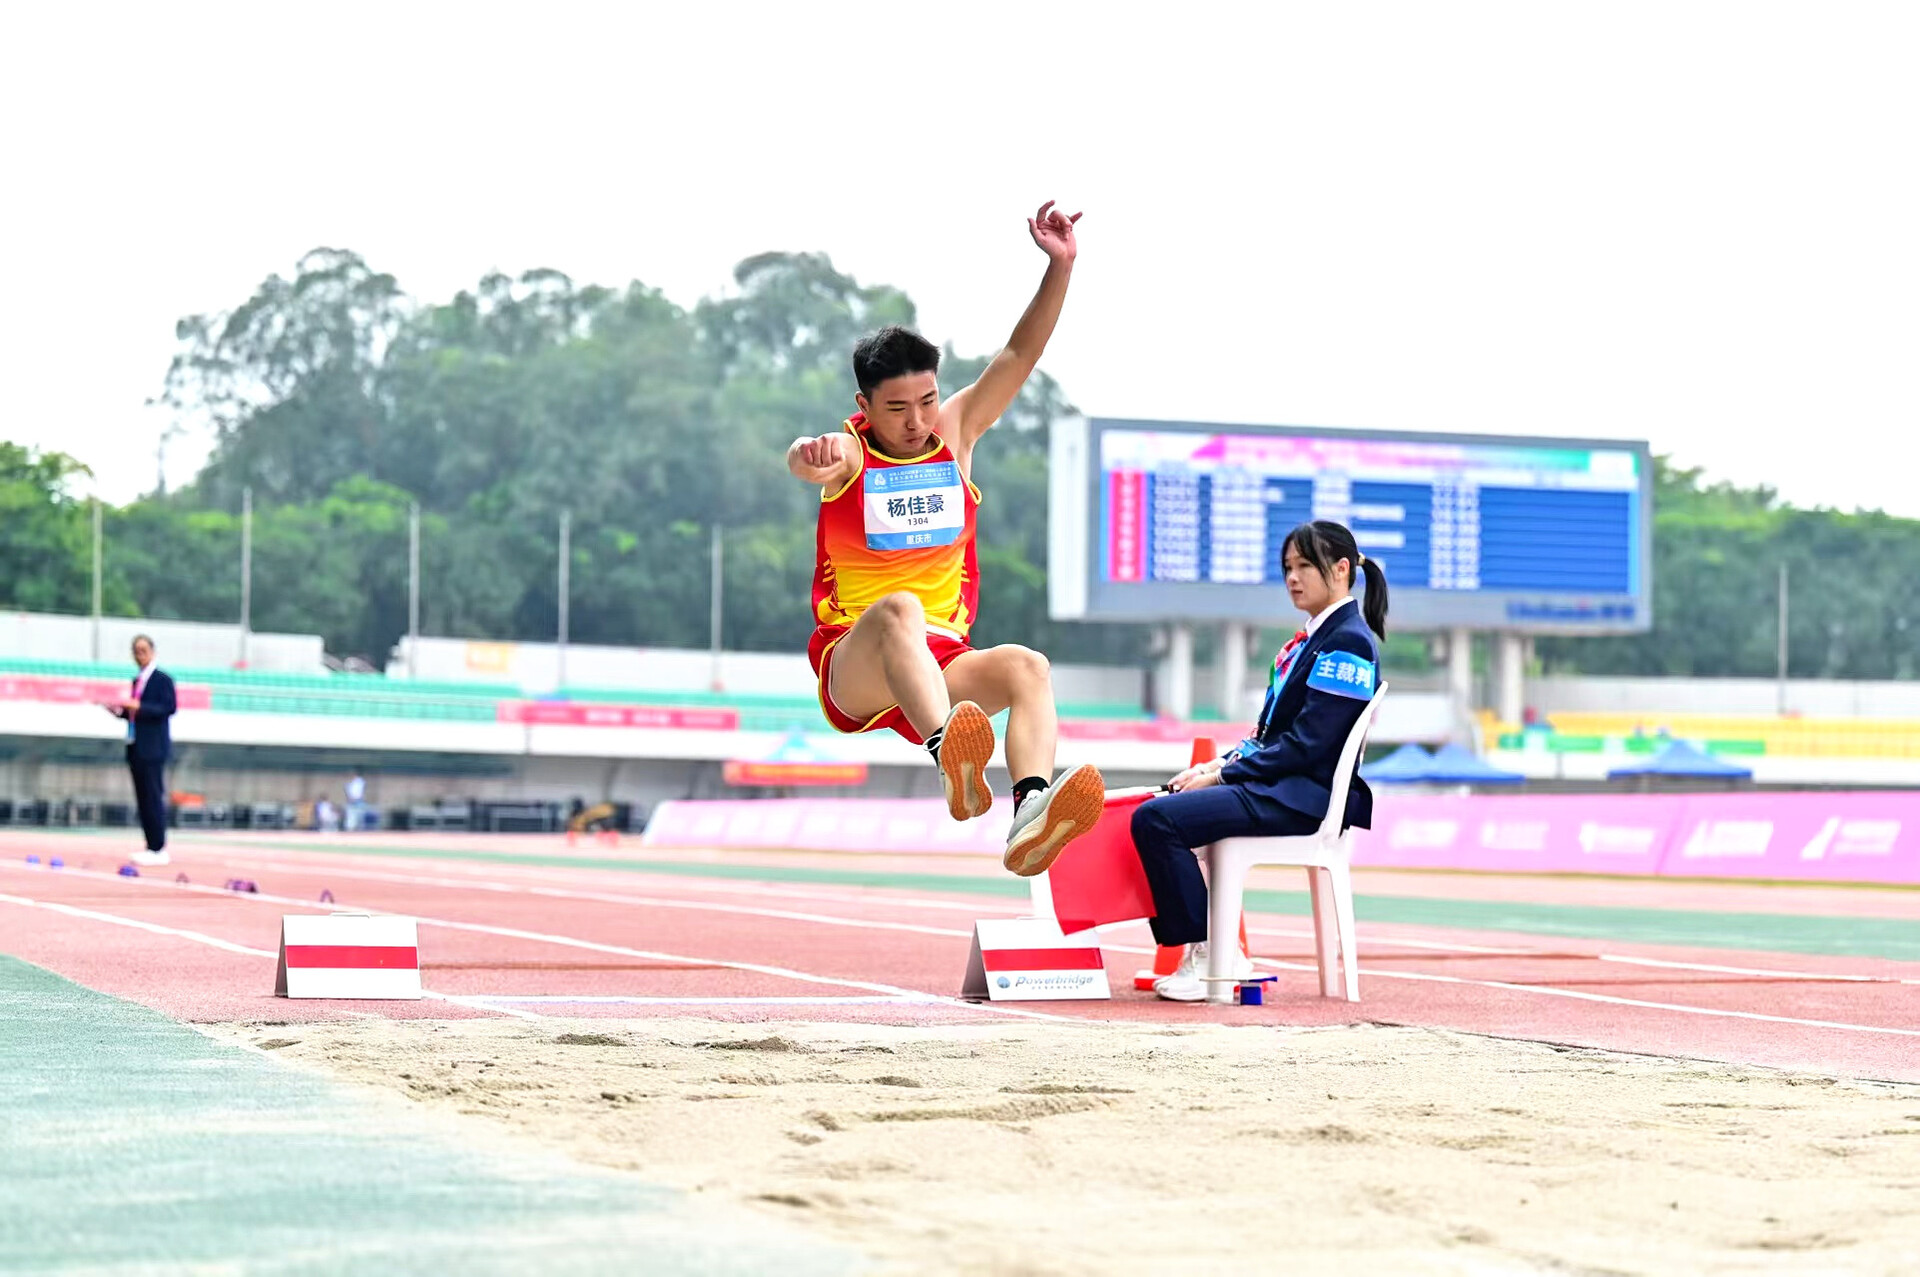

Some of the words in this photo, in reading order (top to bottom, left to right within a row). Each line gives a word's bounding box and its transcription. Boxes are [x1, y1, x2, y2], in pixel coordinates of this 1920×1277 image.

[887, 494, 944, 517] 杨佳豪
[907, 517, 929, 526] 1304
[906, 533, 932, 545] 重庆市
[1317, 659, 1371, 688] 主裁判
[1015, 974, 1093, 987] Powerbridge
